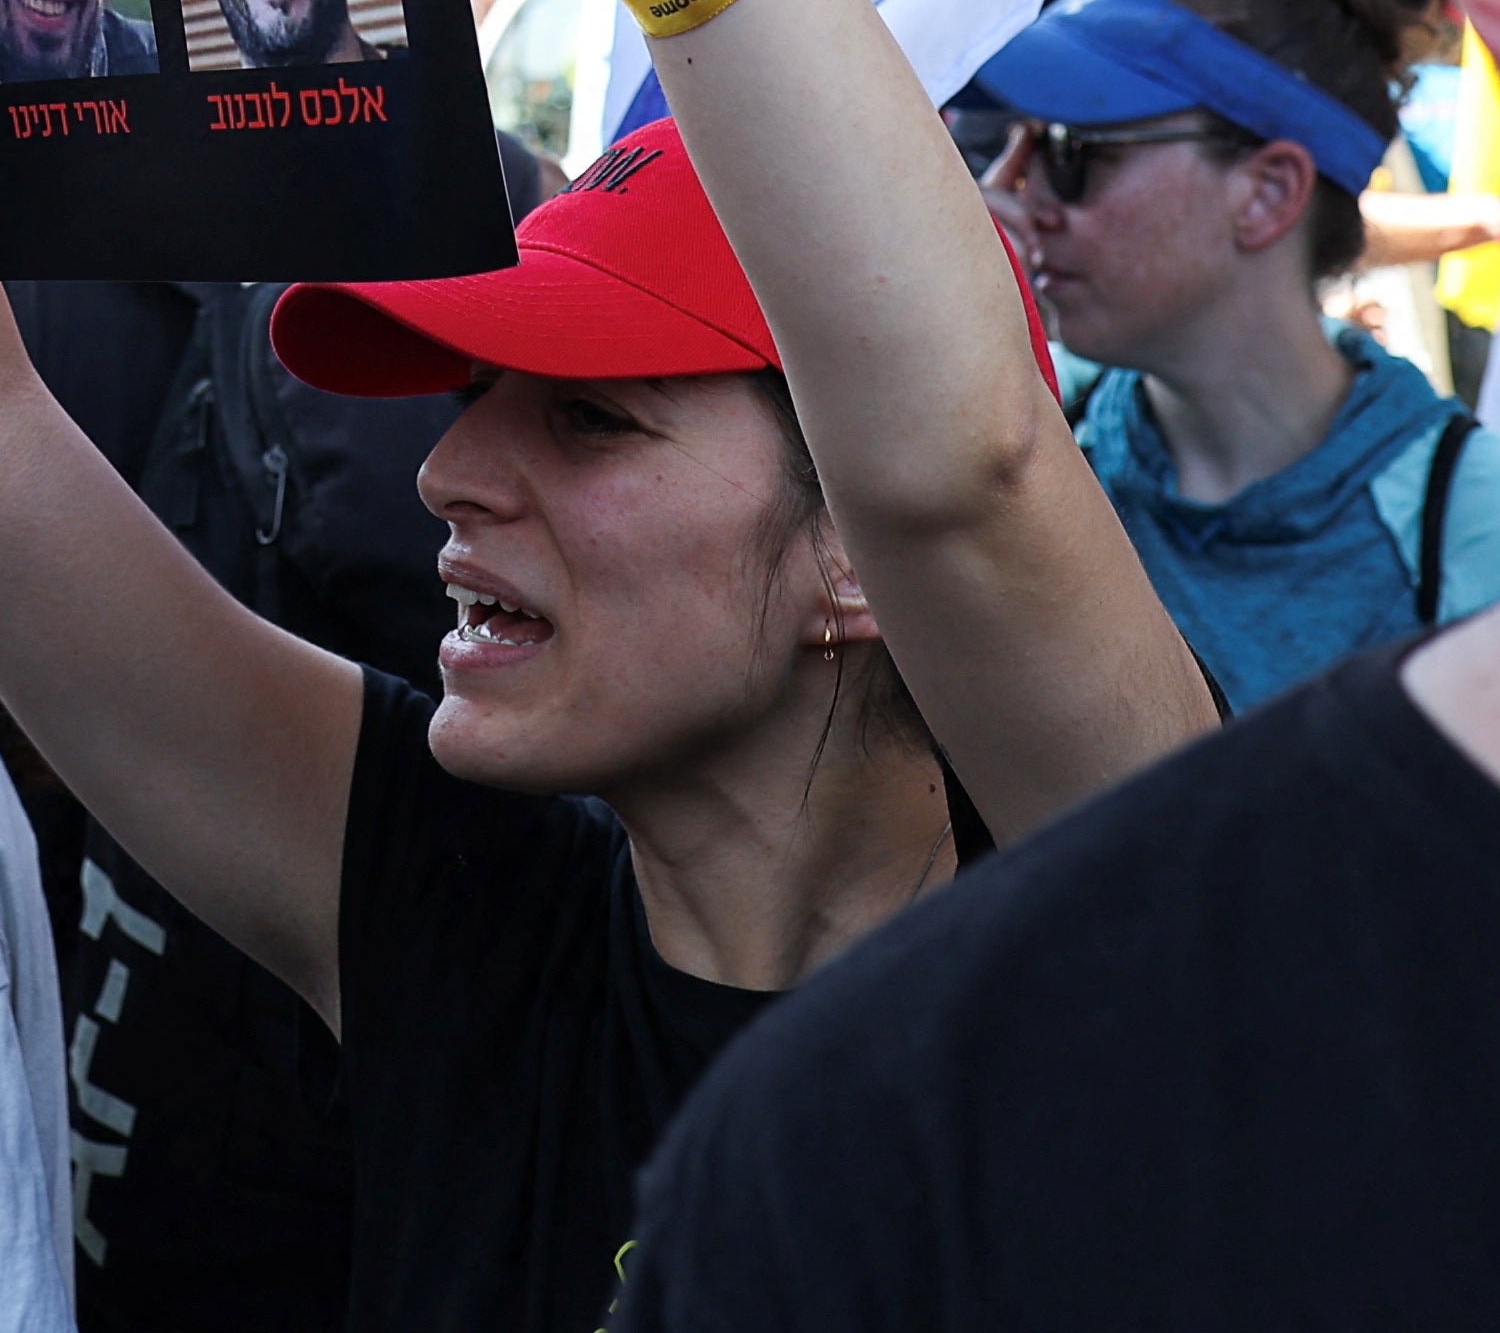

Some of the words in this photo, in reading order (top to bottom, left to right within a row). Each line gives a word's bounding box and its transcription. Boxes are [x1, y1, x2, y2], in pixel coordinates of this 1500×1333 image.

[7, 101, 70, 139] דנינו
[72, 99, 131, 134] אורי
[206, 81, 293, 132] לובנוב
[297, 76, 389, 128] אלכס
[553, 146, 664, 195] OW.
